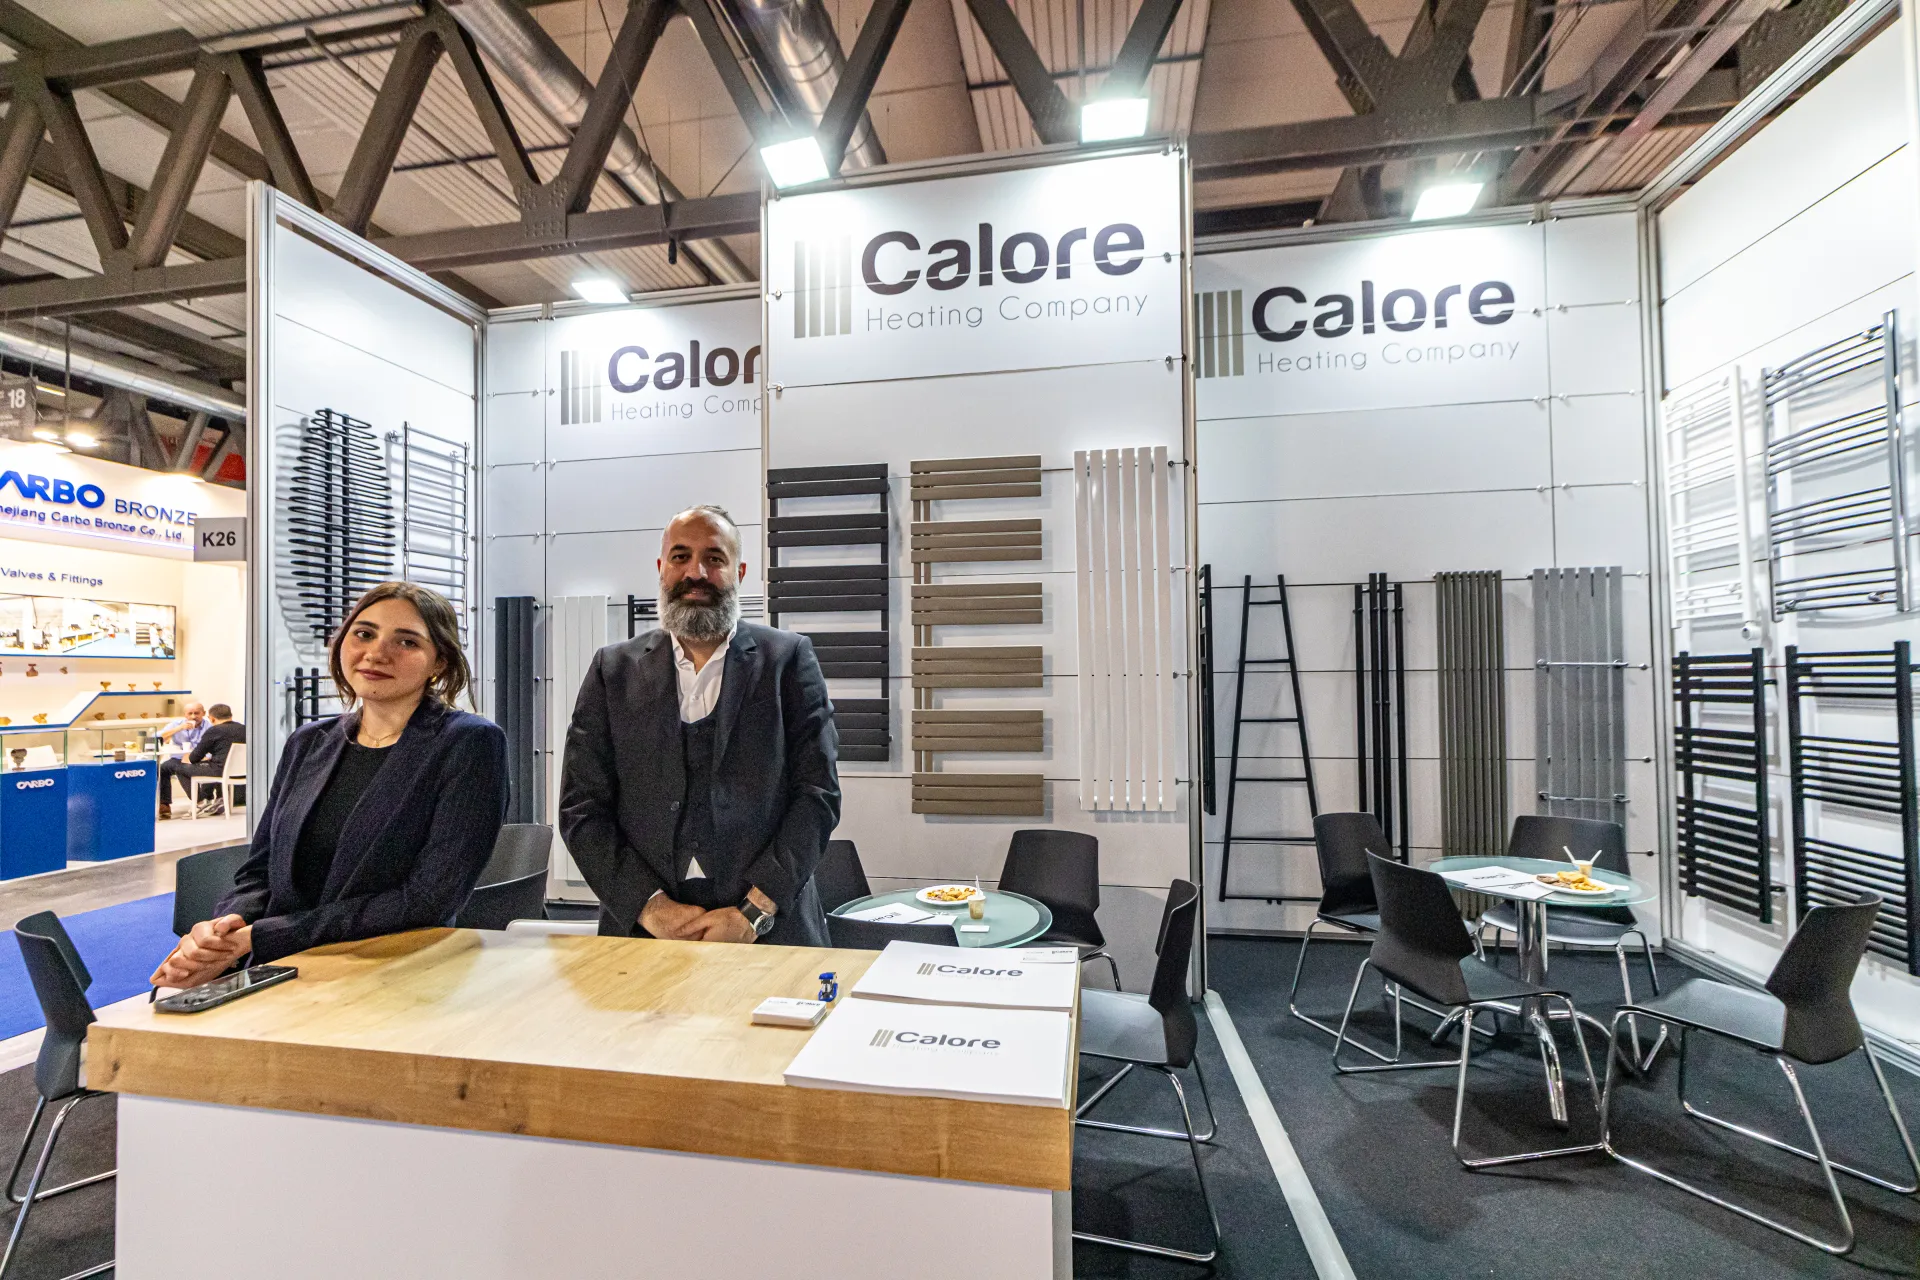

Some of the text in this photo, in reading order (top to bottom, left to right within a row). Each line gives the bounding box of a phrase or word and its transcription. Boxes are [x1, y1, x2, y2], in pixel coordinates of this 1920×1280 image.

[861, 222, 1145, 296] Calore
[866, 294, 1148, 332] Heating Company
[1251, 280, 1516, 343] Calore
[607, 339, 761, 394] Calor
[1258, 340, 1520, 374] Heating Company
[7, 388, 26, 409] 18
[611, 394, 761, 421] Heating Comp
[0, 470, 198, 526] ARBO BRONZE
[51, 511, 91, 526] Carbo
[94, 517, 136, 533] Bronze
[202, 531, 236, 547] K26
[0, 567, 104, 587] Valves & Fittings
[937, 964, 1024, 977] Calore
[895, 1031, 1001, 1049] Calore
